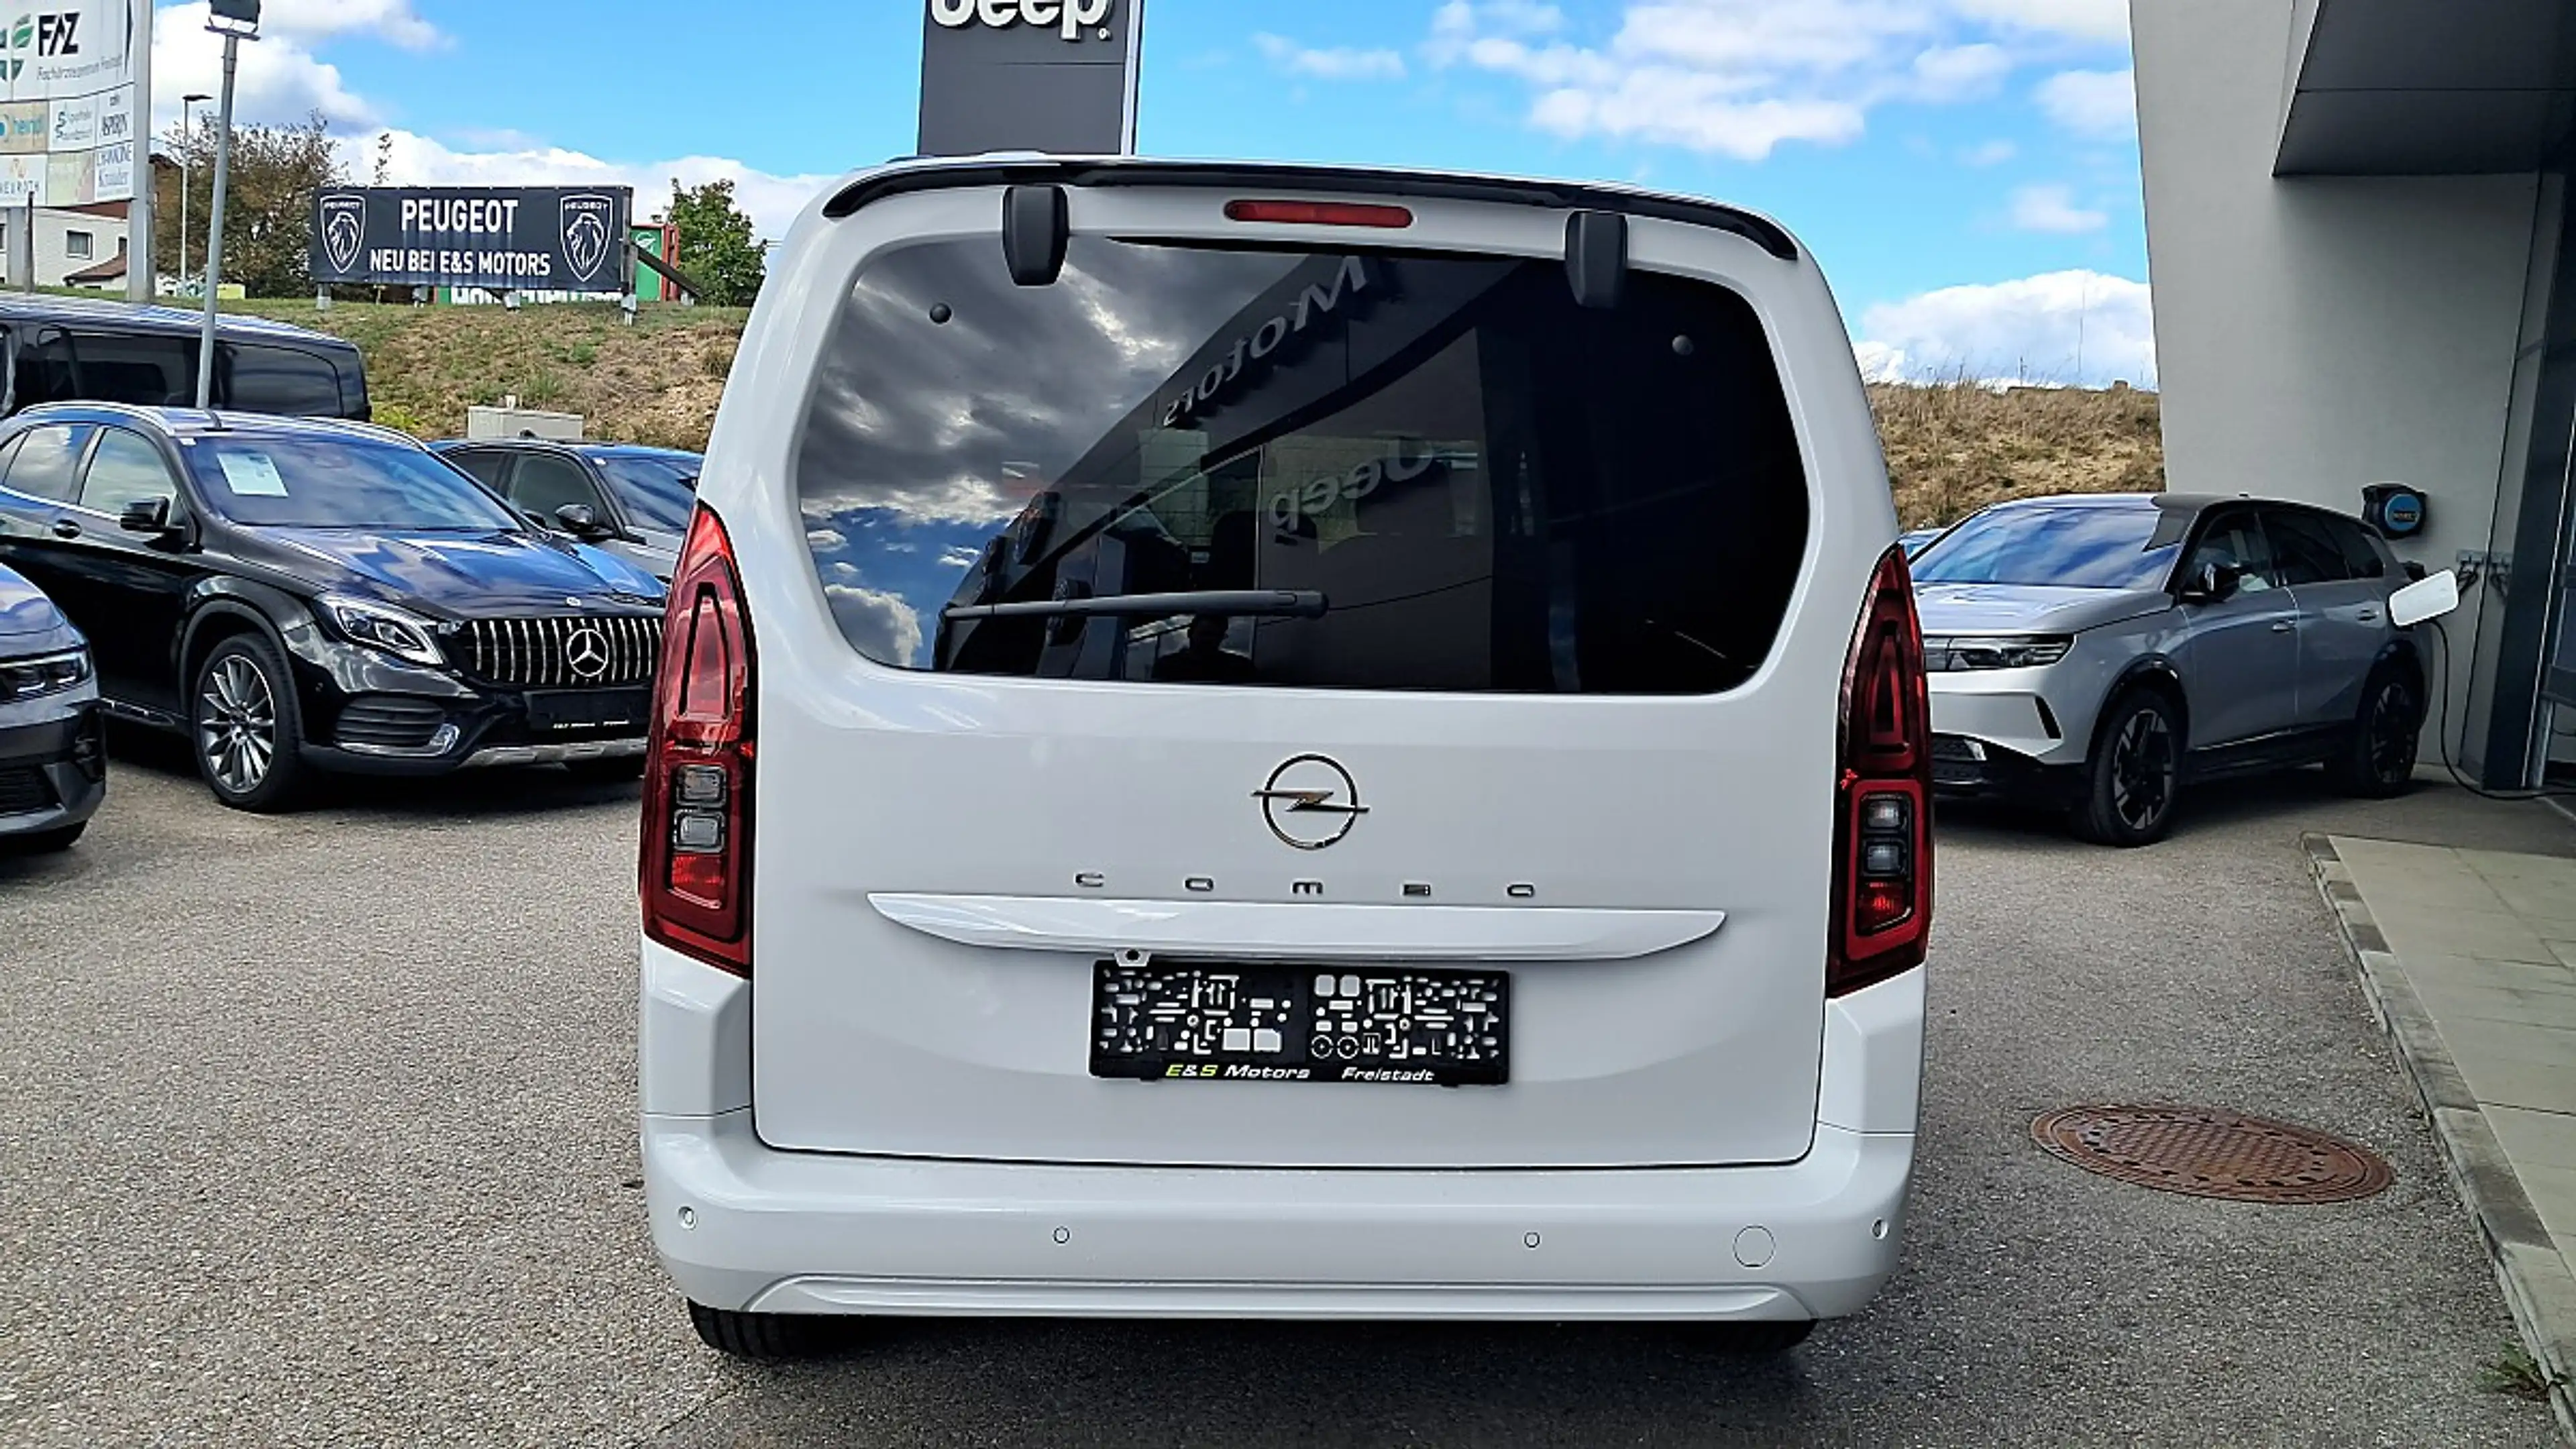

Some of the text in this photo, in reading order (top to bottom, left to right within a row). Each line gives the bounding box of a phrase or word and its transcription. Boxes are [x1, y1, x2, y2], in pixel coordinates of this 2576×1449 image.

[38, 13, 80, 56] FAZ
[401, 199, 519, 233] PEUGEOT
[370, 249, 551, 276] NEU BEI E&S MOTORS
[1075, 872, 1535, 898] COMBO
[1165, 1064, 1435, 1081] E&S Motors Freistadt
